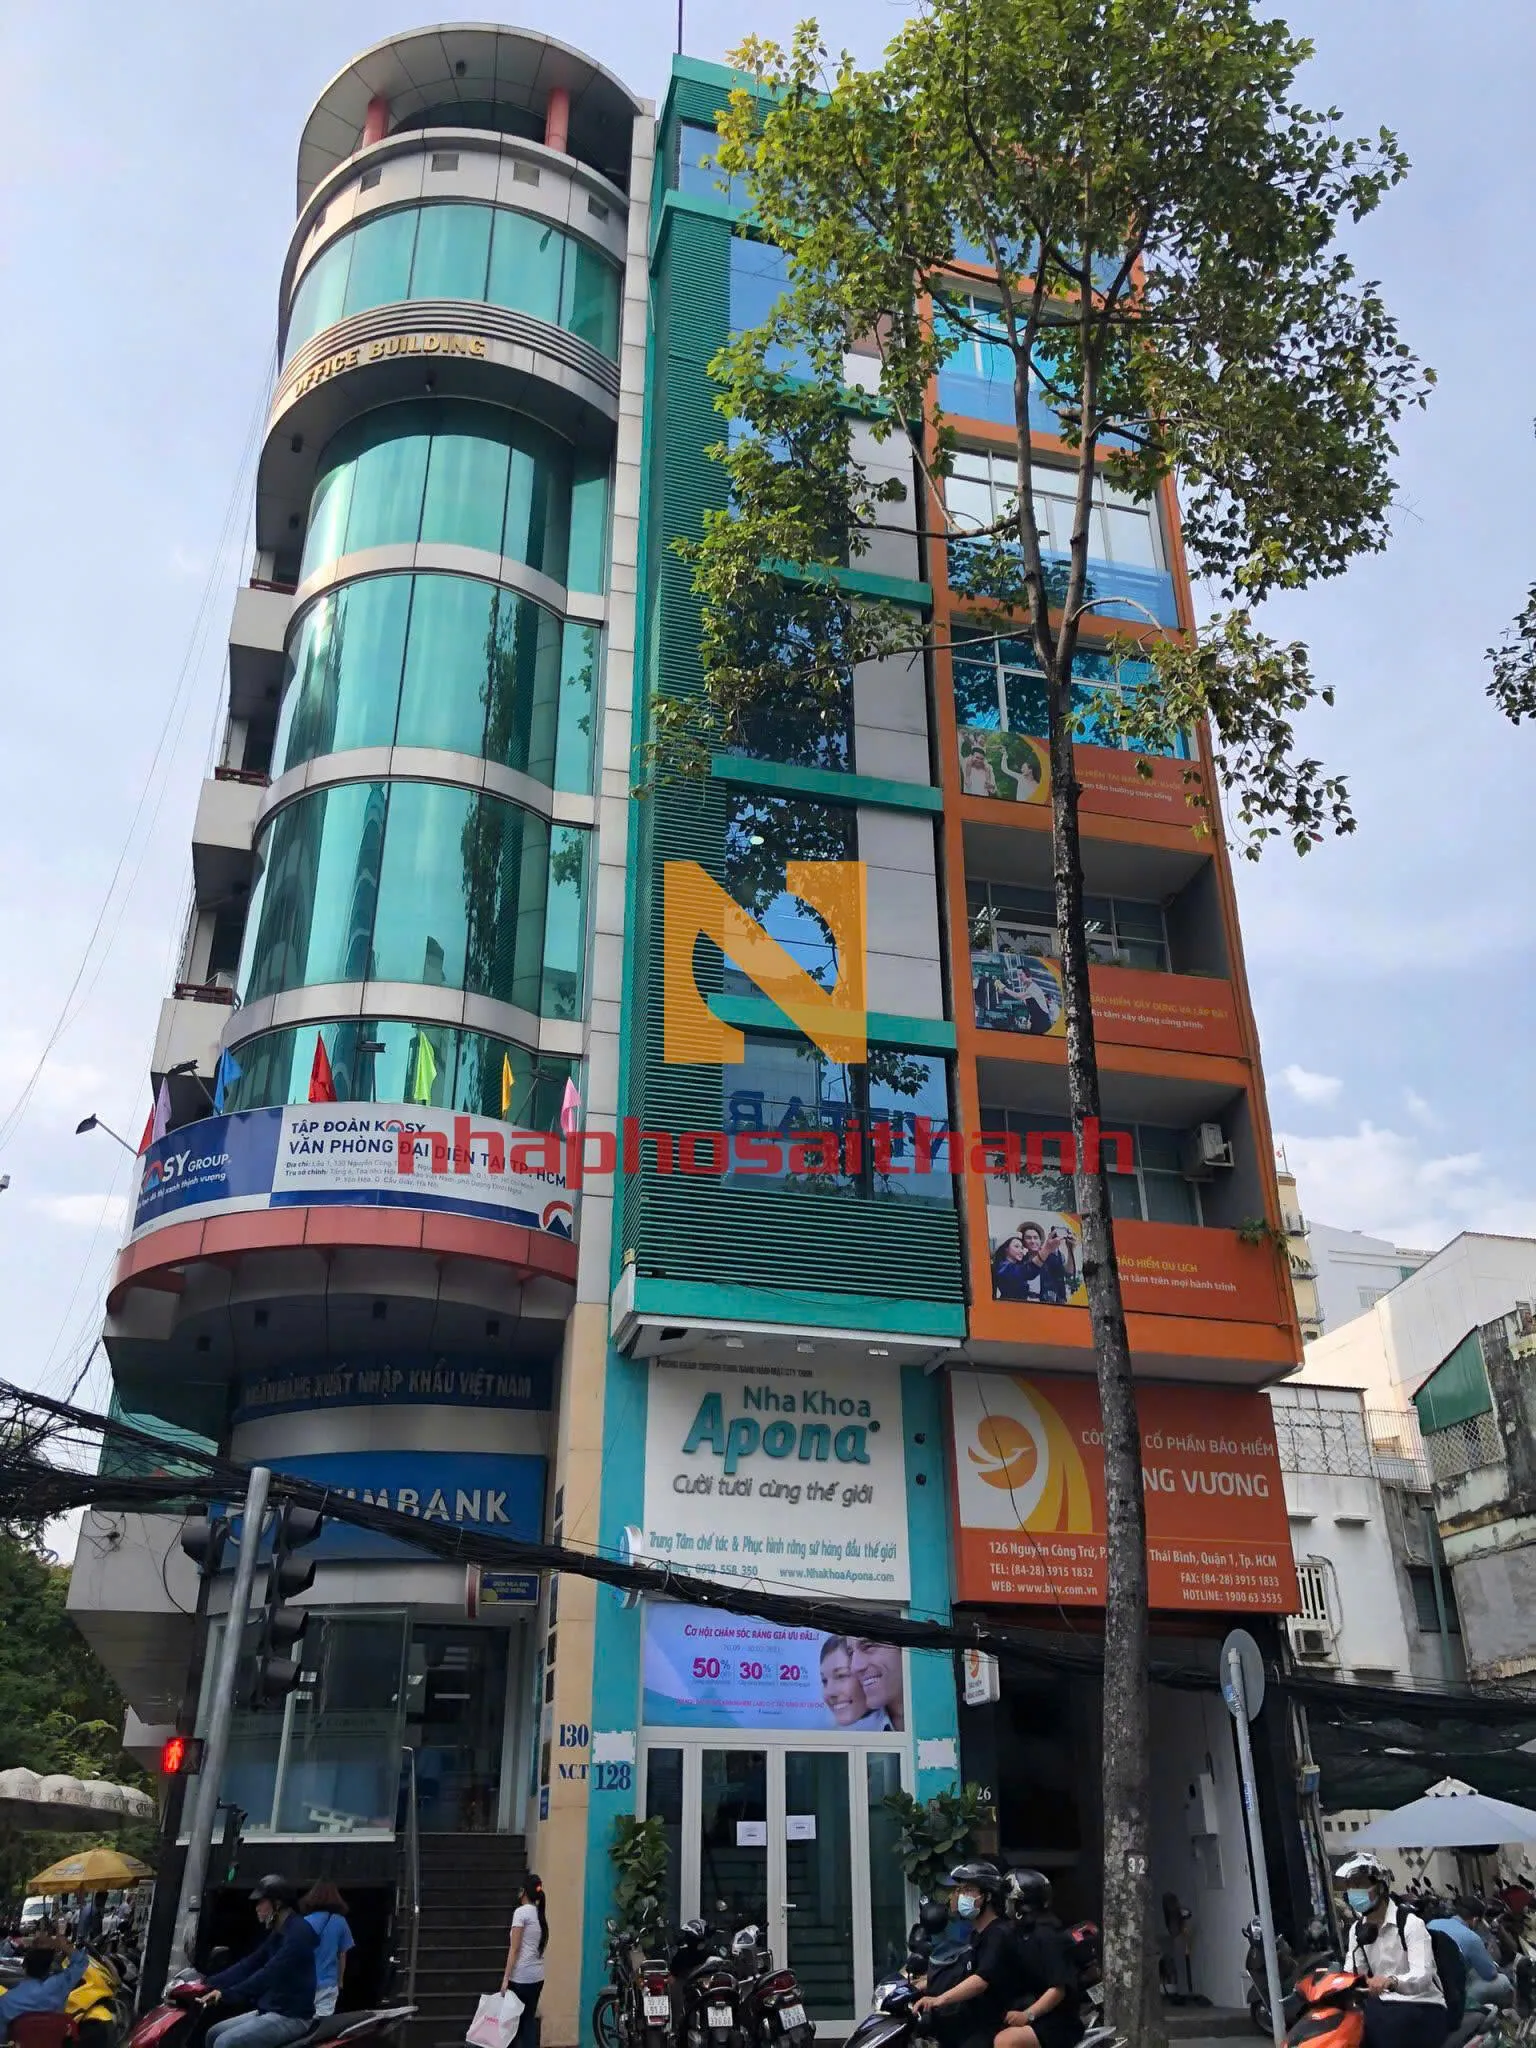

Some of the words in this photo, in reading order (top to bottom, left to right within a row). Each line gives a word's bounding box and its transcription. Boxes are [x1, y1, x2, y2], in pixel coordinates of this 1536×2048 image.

[296, 349, 360, 397] OFFICE
[369, 334, 486, 358] BUILDING
[291, 1119, 319, 1137] TẬP
[323, 1117, 371, 1132] ĐOÀN
[187, 1153, 230, 1173] GROUP
[289, 1136, 325, 1155] VĂN
[329, 1135, 394, 1154] PHÒNG
[536, 1168, 567, 1190] HCM
[358, 1363, 404, 1398] NHẬP
[408, 1357, 455, 1394] KHẨU
[459, 1367, 494, 1400] VIỆT
[496, 1376, 532, 1399] NAM
[743, 1385, 796, 1413] Nha
[802, 1390, 871, 1418] Khoa
[682, 1391, 871, 1475] Apona
[1167, 1434, 1206, 1453] PHẦN
[1209, 1437, 1238, 1454] BẢO
[1242, 1436, 1275, 1457] HIỂM
[759, 1479, 802, 1505] cùng
[806, 1480, 841, 1501] thế
[1181, 1469, 1270, 1498] VƯƠNG
[649, 1531, 674, 1553] Trung
[676, 1532, 694, 1550] Tâm
[732, 1535, 739, 1551] &
[989, 1541, 1009, 1555] 126
[1051, 1544, 1077, 1561] Công
[1149, 1548, 1171, 1562] Thái
[1200, 1551, 1227, 1568] Quận
[1239, 1553, 1255, 1569] Tp.
[1256, 1554, 1277, 1568] HCM
[741, 1565, 758, 1577] 350
[989, 1562, 1010, 1575] TEL:
[1011, 1563, 1045, 1577] (84-28)
[1071, 1567, 1094, 1577] 1832
[1181, 1572, 1200, 1585] FAX:
[1201, 1572, 1233, 1586] (84-28)
[1235, 1574, 1257, 1586] 3915
[1258, 1575, 1280, 1587] 1833
[991, 1580, 1016, 1593] WEB:
[1182, 1588, 1223, 1601] HOTLINE:
[1225, 1591, 1247, 1603] 1900
[1248, 1591, 1260, 1603] 63
[1261, 1592, 1283, 1604] 3535
[736, 1627, 751, 1639] SÓC
[559, 1724, 589, 1748] 130
[594, 1763, 632, 1791] 128
